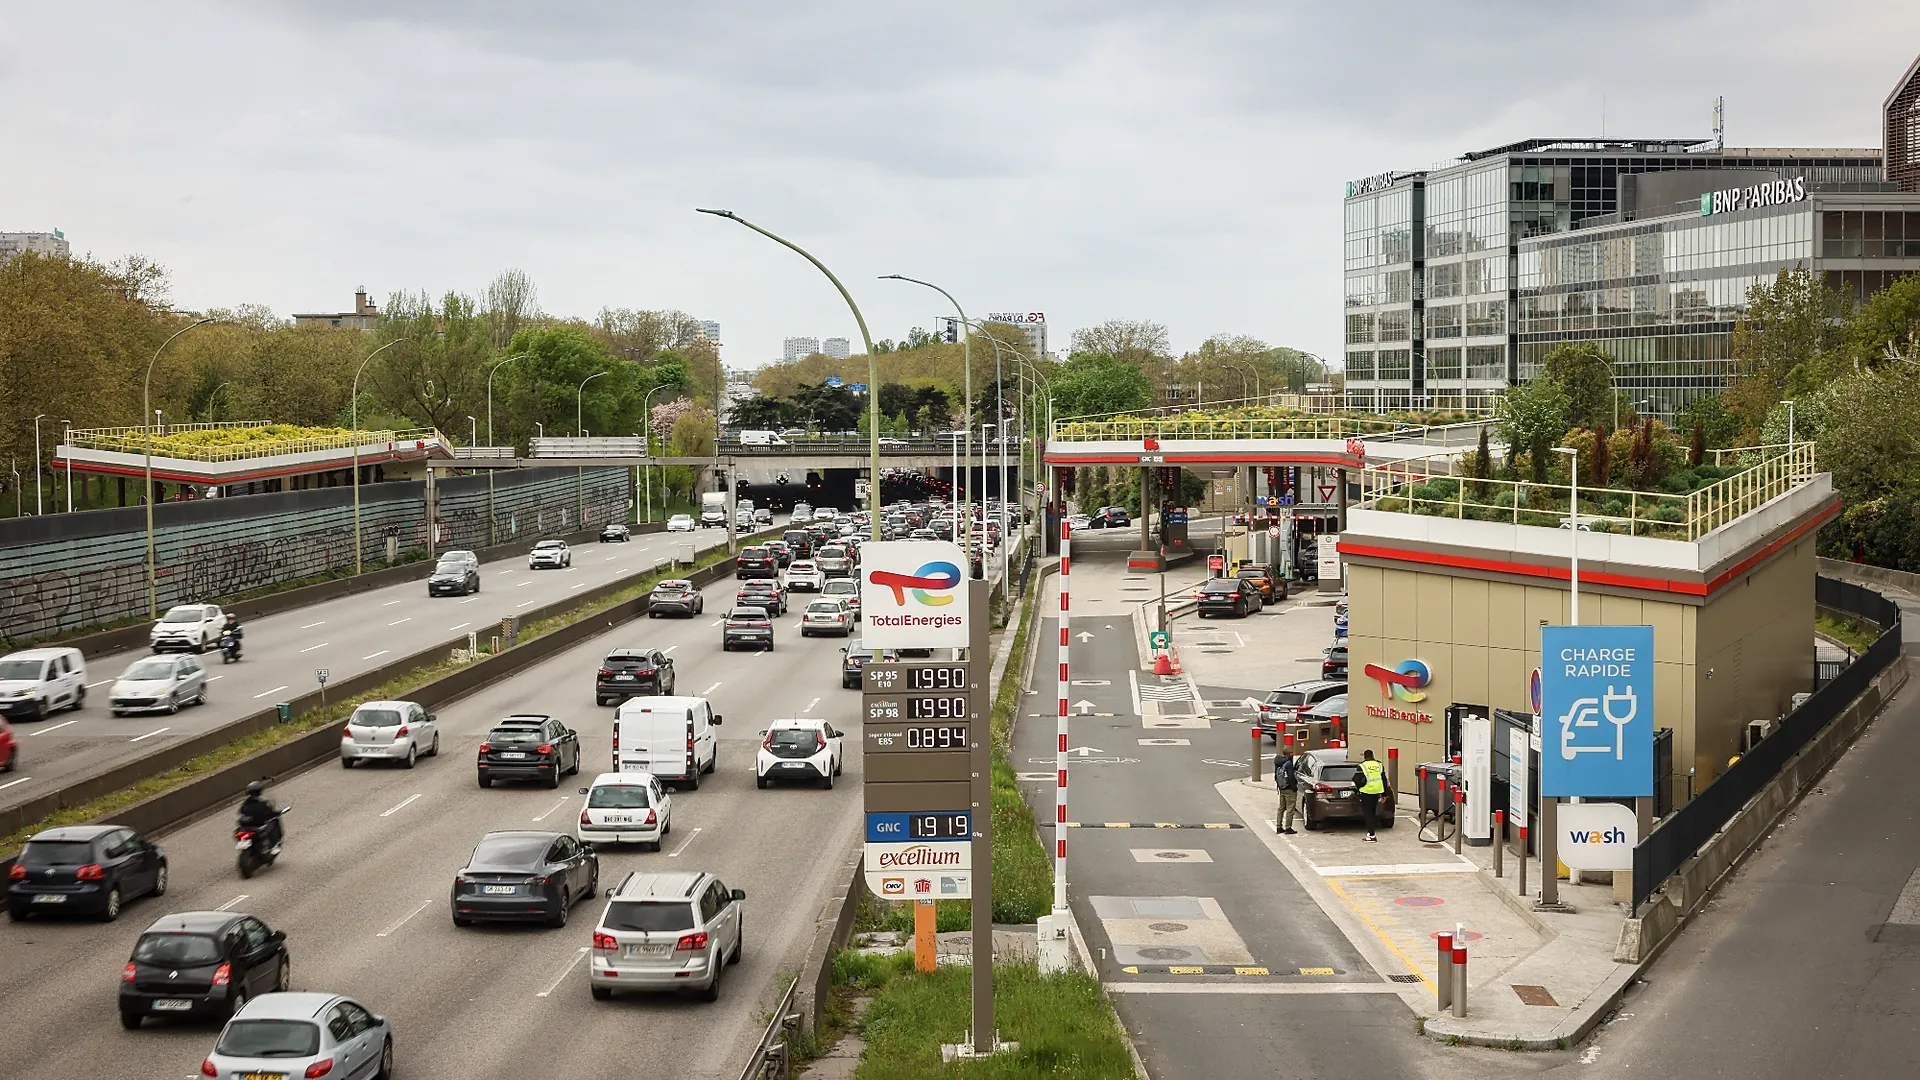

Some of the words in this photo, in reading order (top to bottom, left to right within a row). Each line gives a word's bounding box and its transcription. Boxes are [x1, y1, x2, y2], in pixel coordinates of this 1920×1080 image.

[1351, 177, 1365, 197] BNP
[1365, 170, 1394, 192] PARIBAS
[1712, 187, 1741, 214] BNP
[1744, 176, 1806, 208] PARIBAS
[1256, 492, 1294, 506] wash
[869, 615, 962, 628] TotalEnergies
[1560, 648, 1636, 662] CHARGE
[870, 671, 884, 681] SP
[885, 670, 898, 681] 95
[1565, 664, 1632, 678] RAPIDE
[877, 680, 892, 688] E10
[914, 668, 965, 689] 1.990
[870, 708, 884, 718] SP
[885, 708, 899, 718] 98
[915, 698, 966, 719] 1.990
[1365, 704, 1433, 724] TotalEnergies
[878, 737, 893, 746] E85
[907, 727, 966, 748] 0.894
[876, 822, 901, 833] GNC
[1569, 826, 1625, 845] wash
[879, 848, 960, 866] excellium
